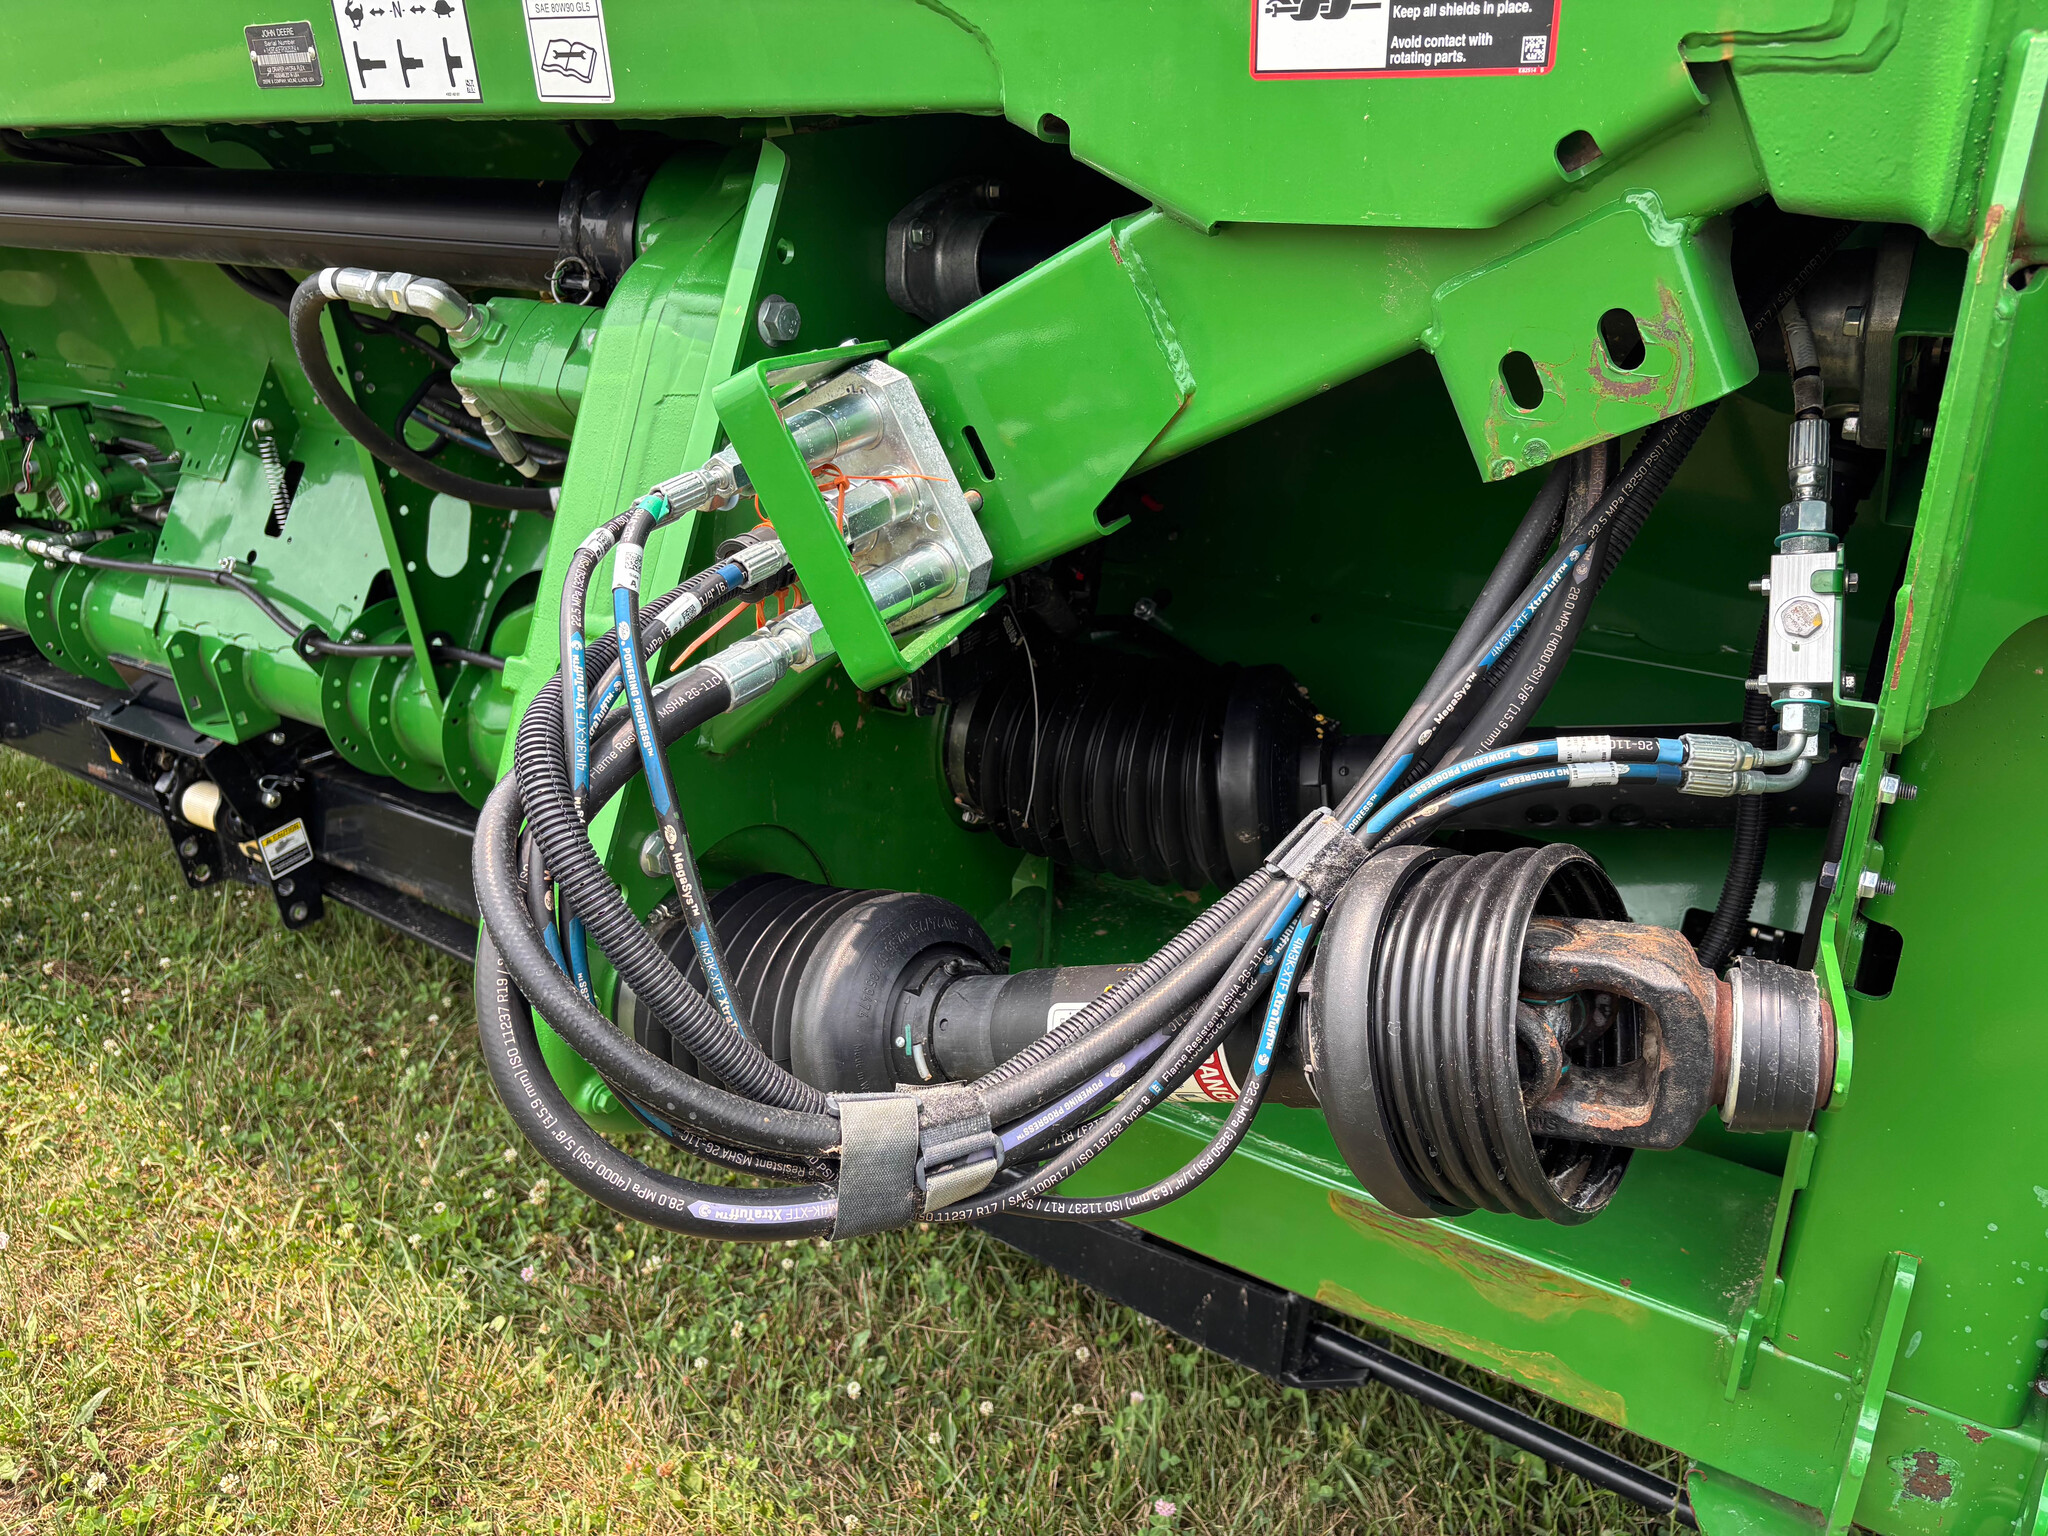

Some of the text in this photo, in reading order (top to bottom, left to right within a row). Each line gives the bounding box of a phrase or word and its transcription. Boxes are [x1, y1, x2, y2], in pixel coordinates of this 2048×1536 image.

[534, 2, 590, 14] SAE 80W90 GL5
[1392, 0, 1532, 21] Keep all shields in place.
[261, 27, 294, 38] JOHN DEERE
[1390, 32, 1493, 49] Avoid contact with
[1390, 50, 1466, 67] rotating parts.
[1588, 515, 1608, 539] 22.5
[1605, 496, 1625, 518] MPa
[571, 590, 583, 606] MPa
[1564, 585, 1581, 610] 28.0
[570, 608, 582, 628] 22.5
[1554, 610, 1572, 632] MPa
[1490, 611, 1529, 657] 4M3K-XTF
[644, 638, 663, 656] MPa
[622, 647, 640, 697] POWERING
[657, 676, 722, 718] MSHA 2G-11C
[575, 710, 588, 772] 4M3K-XTF
[1460, 751, 1511, 772] POWERING
[700, 940, 726, 996] 4M3K-XTF
[1279, 937, 1304, 991] 4M3K-XTF
[496, 978, 509, 1002] R19
[498, 1006, 516, 1047] 11237
[507, 1048, 524, 1069] ISO
[934, 1209, 973, 1222] 11237
[976, 1202, 998, 1217] R17
[1008, 1190, 1030, 1206] SAE
[1032, 1165, 1070, 1196] 100R17
[1076, 1148, 1095, 1167] ISO
[1094, 1122, 1124, 1152] 18752
[1122, 1104, 1144, 1127] Type
[1141, 1094, 1151, 1106] B
[1162, 1053, 1188, 1083] Flame
[1185, 1010, 1222, 1054] Resistant
[1218, 984, 1242, 1013] MSHA
[1238, 947, 1267, 984] 2G-11C
[1064, 1079, 1104, 1111] POWERING
[1242, 1080, 1260, 1106] 22.5
[1230, 1105, 1250, 1129] MPa
[680, 1130, 720, 1156] 2G-11C
[722, 1150, 753, 1167] MSHA
[755, 1159, 806, 1178] Resistant
[632, 1182, 657, 1203] MPa
[658, 1194, 685, 1212] 28.0
[1043, 1203, 1066, 1214] R17
[1066, 1200, 1104, 1214] 11237
[1104, 1200, 1124, 1213] ISO
